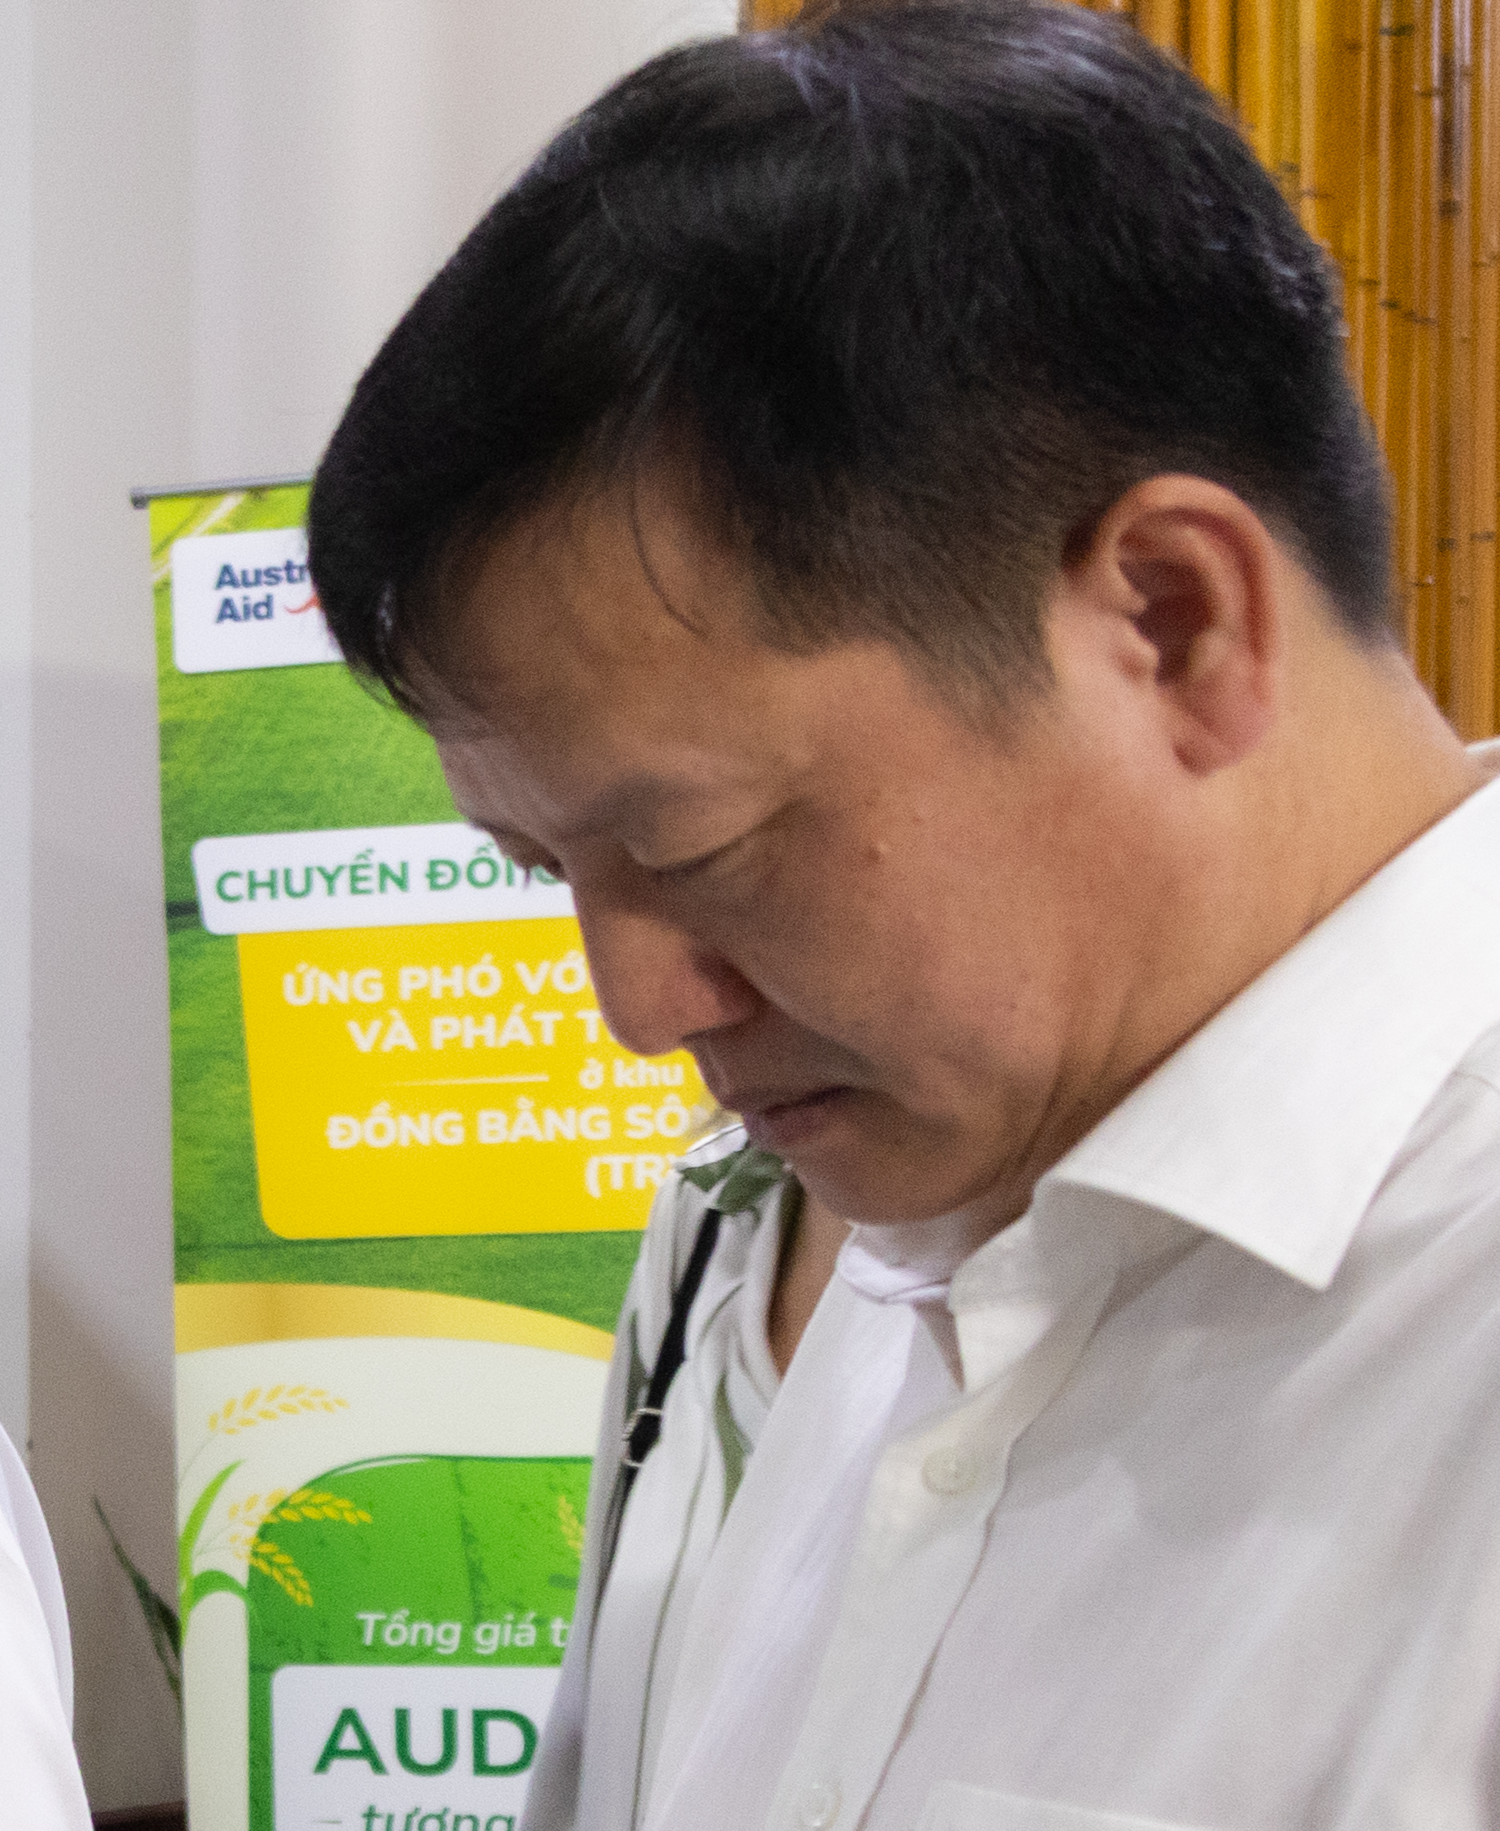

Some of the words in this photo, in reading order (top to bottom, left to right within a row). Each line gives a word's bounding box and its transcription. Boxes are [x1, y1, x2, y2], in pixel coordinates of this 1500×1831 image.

[214, 592, 274, 624] Aid
[216, 849, 408, 903] CHUYỂN
[283, 963, 383, 1006] ỨNG
[400, 953, 501, 1000] PHÓ
[347, 1009, 417, 1053] VÀ
[431, 1004, 563, 1051] PHÁT
[579, 1057, 604, 1089] ở
[613, 1059, 683, 1088] khu
[326, 1101, 464, 1150] ĐỒNG
[477, 1095, 610, 1145] BẰNG
[356, 1609, 462, 1655] Tổng
[474, 1611, 537, 1655] giá
[314, 1707, 540, 1777] AUD
